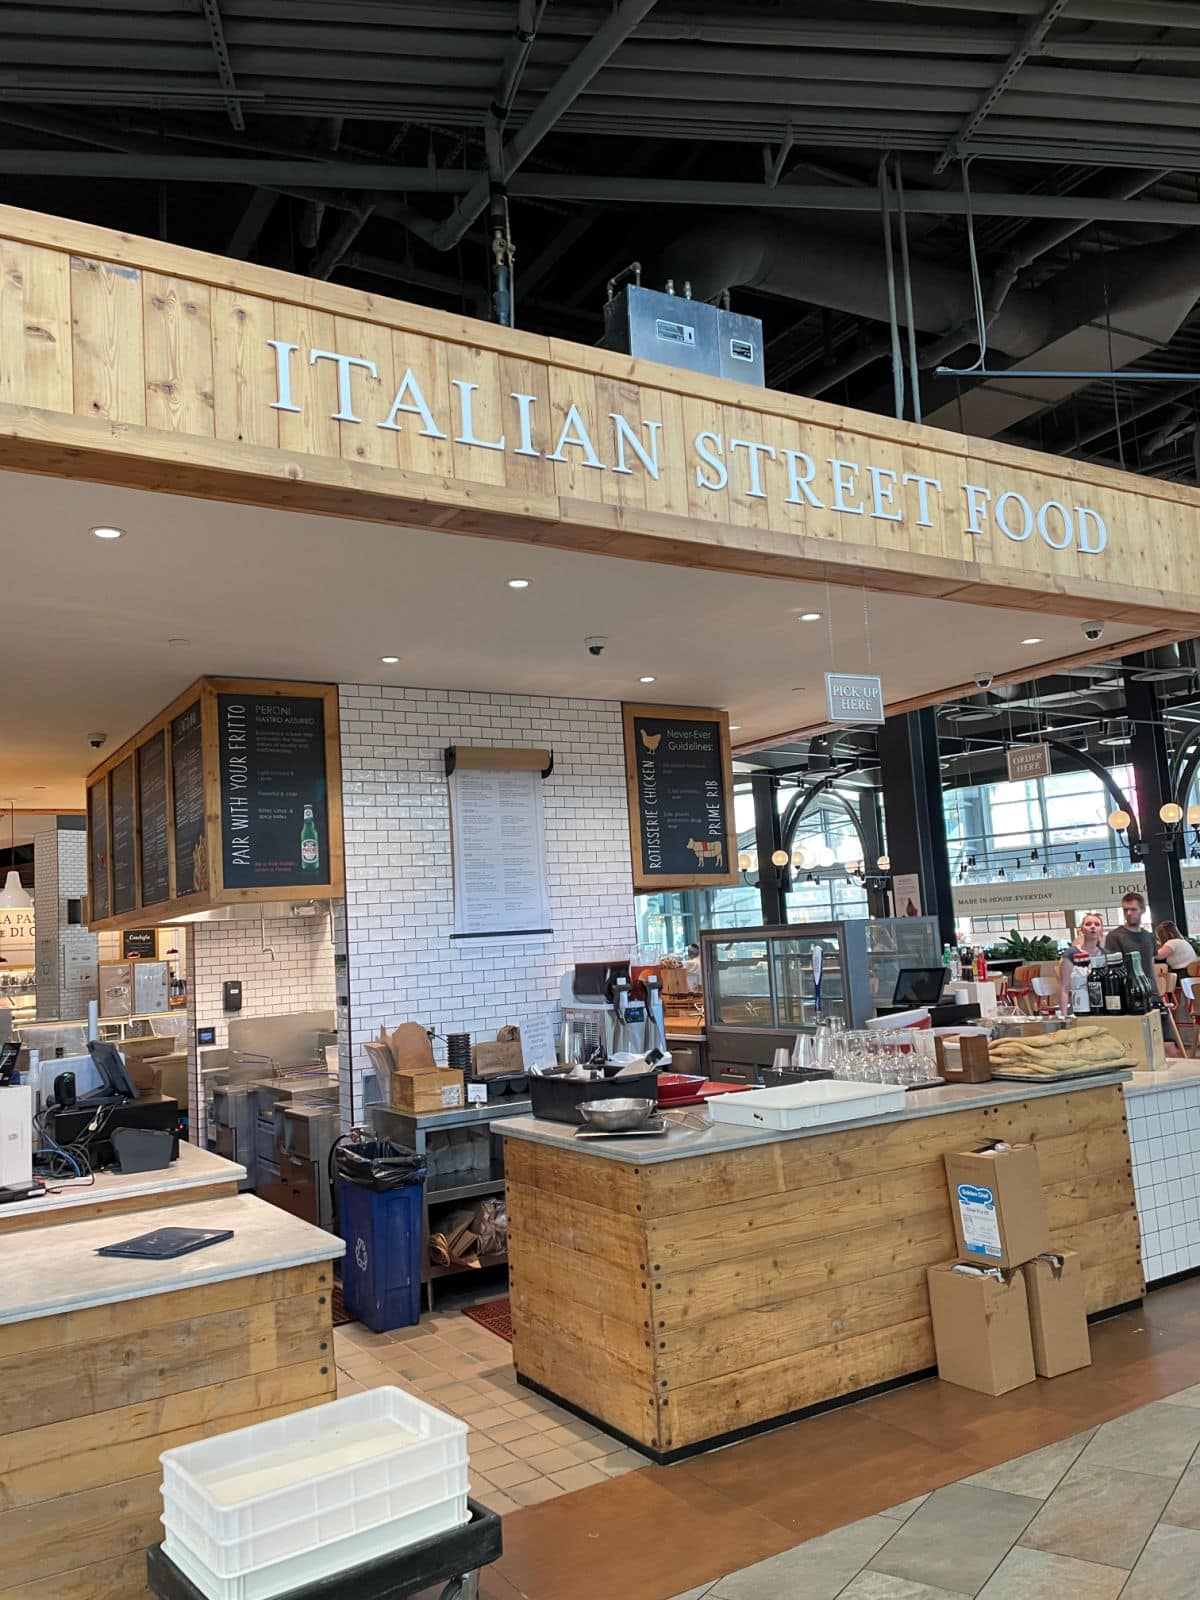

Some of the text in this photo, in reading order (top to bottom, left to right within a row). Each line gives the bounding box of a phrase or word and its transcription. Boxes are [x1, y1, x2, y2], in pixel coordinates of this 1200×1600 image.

[268, 340, 1108, 555] ITALIAN STREET FOOD
[832, 685, 879, 698] PICK UP
[255, 705, 291, 716] PERONI
[841, 698, 873, 711] HERE
[1012, 752, 1043, 764] ORDER
[1016, 762, 1041, 773] HERE
[227, 704, 250, 865] PAIR WITH YOUR FRITTO
[704, 780, 721, 835] PRIME RIB
[642, 760, 662, 869] ROTISSERIE CHICKEN
[1015, 892, 1053, 902] EVERYDAY
